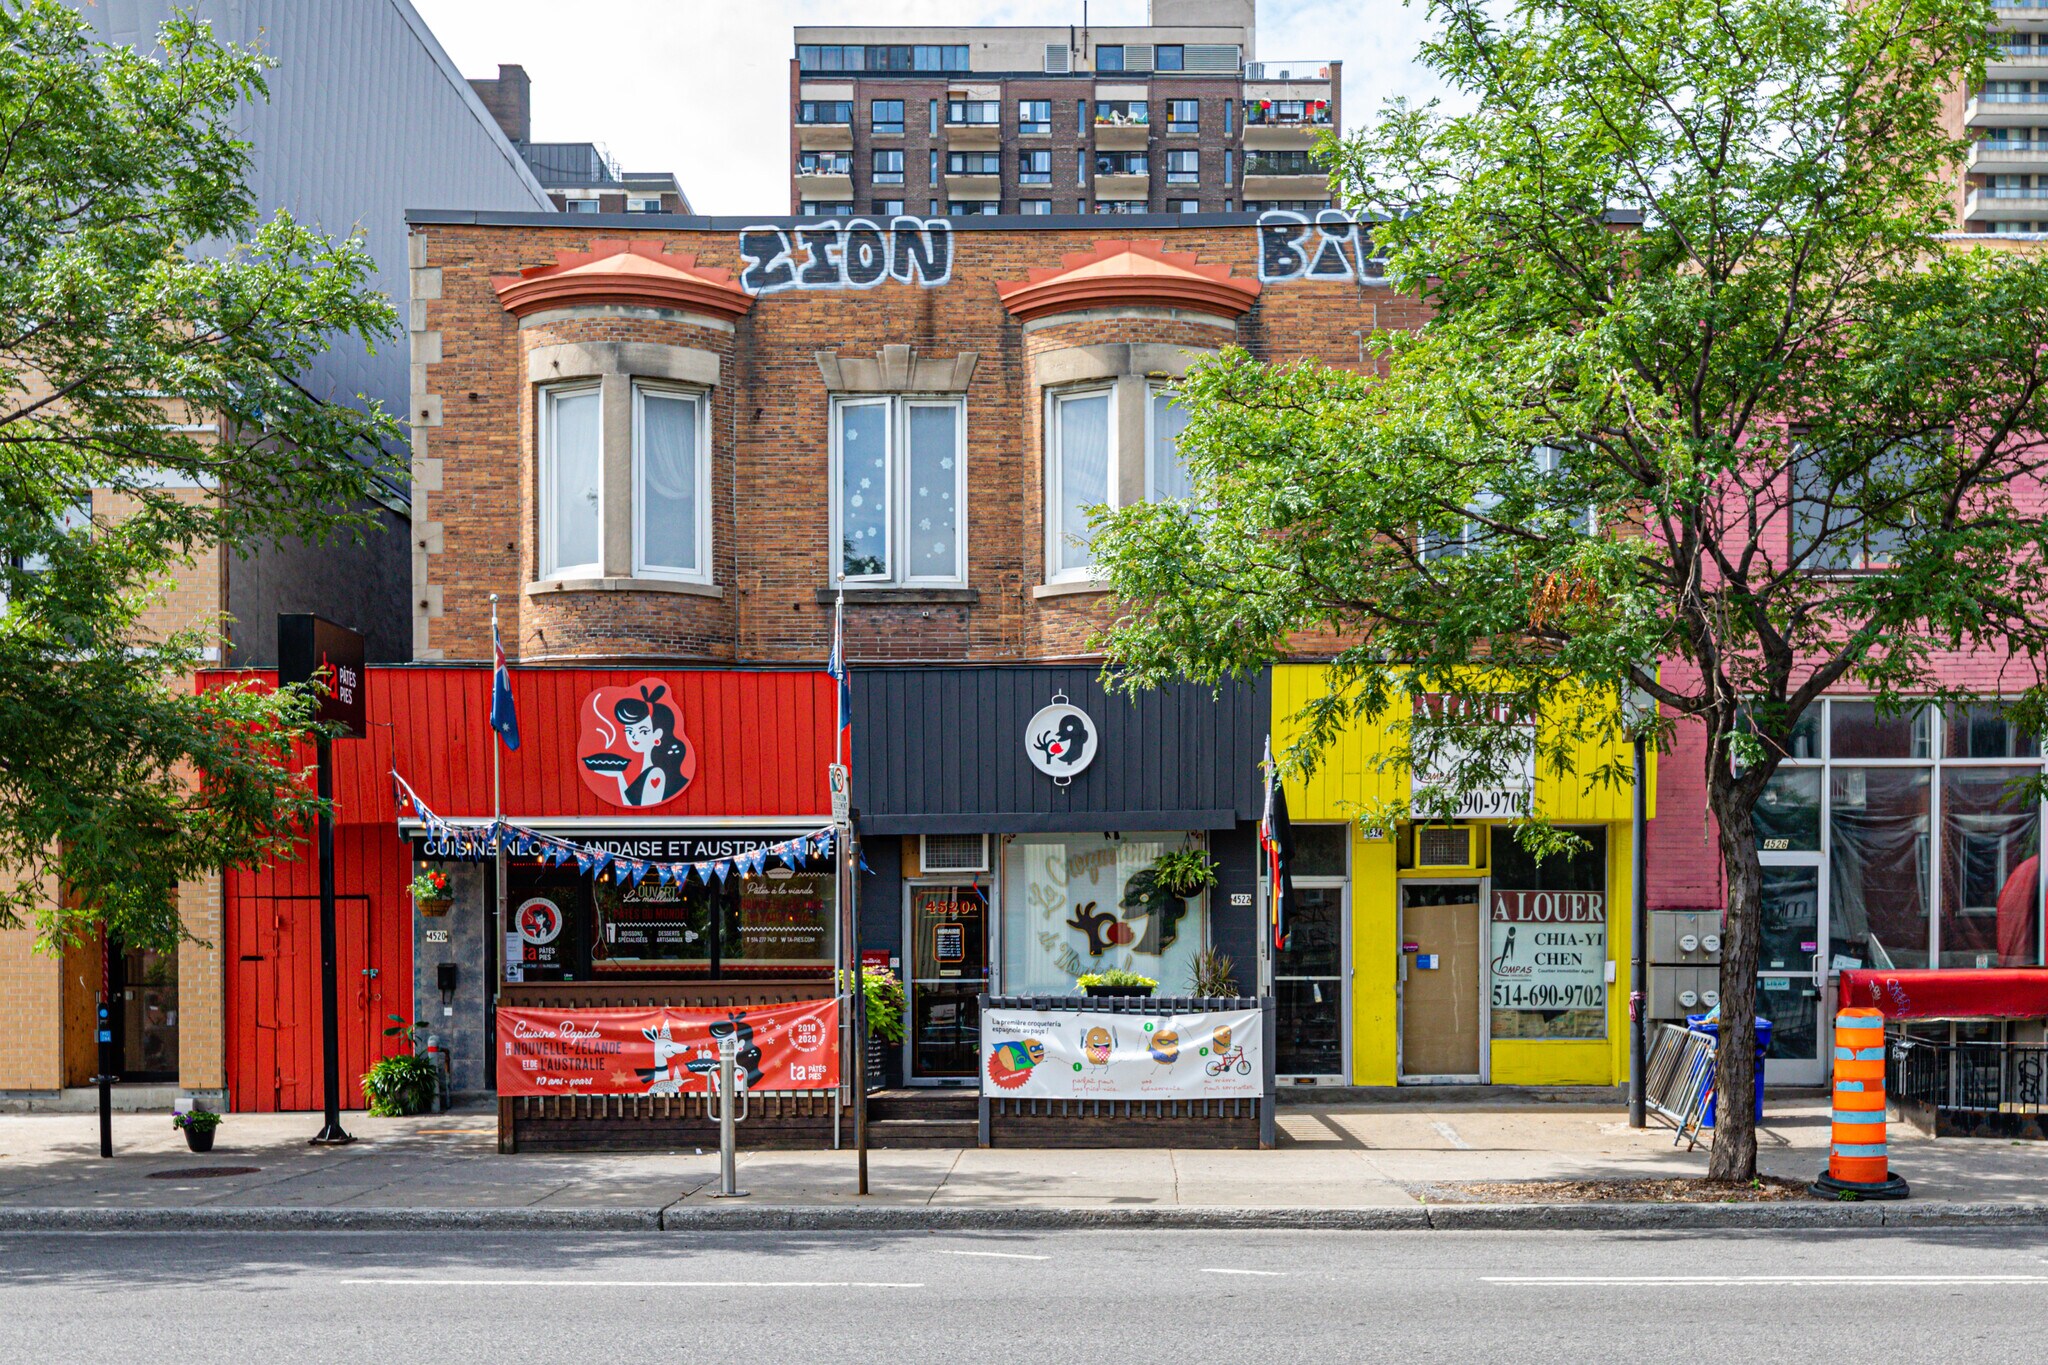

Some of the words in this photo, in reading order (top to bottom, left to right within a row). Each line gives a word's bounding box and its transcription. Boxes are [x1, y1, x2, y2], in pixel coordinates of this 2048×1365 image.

[340, 665, 356, 688] PÂTÉS
[340, 686, 352, 705] PIES
[668, 841, 692, 856] ET
[1765, 840, 1788, 848] 4526
[926, 900, 977, 914] 4520A
[1232, 896, 1250, 904] 4522
[1494, 892, 1510, 920] À
[1517, 892, 1604, 922] LOUER
[429, 931, 446, 940] 4520
[1535, 932, 1604, 946] CHIA-YI
[539, 946, 555, 954] PÂTÉS
[1535, 952, 1582, 966] CHEN
[1492, 984, 1602, 1006] 514-690-9702
[798, 1024, 816, 1032] 2010
[1001, 1019, 1026, 1027] première
[514, 1020, 556, 1039] Cuisine
[560, 1020, 601, 1045] Rapide
[798, 1035, 817, 1043] 2020
[514, 1038, 622, 1055] NOUVELLE-ZÉLANDE
[540, 1057, 605, 1071] L'AUSTRALIE
[790, 1062, 806, 1080] ta
[808, 1064, 826, 1072] PÂTÉS
[536, 1076, 546, 1085] 10
[548, 1076, 563, 1086] ans
[570, 1076, 593, 1087] years
